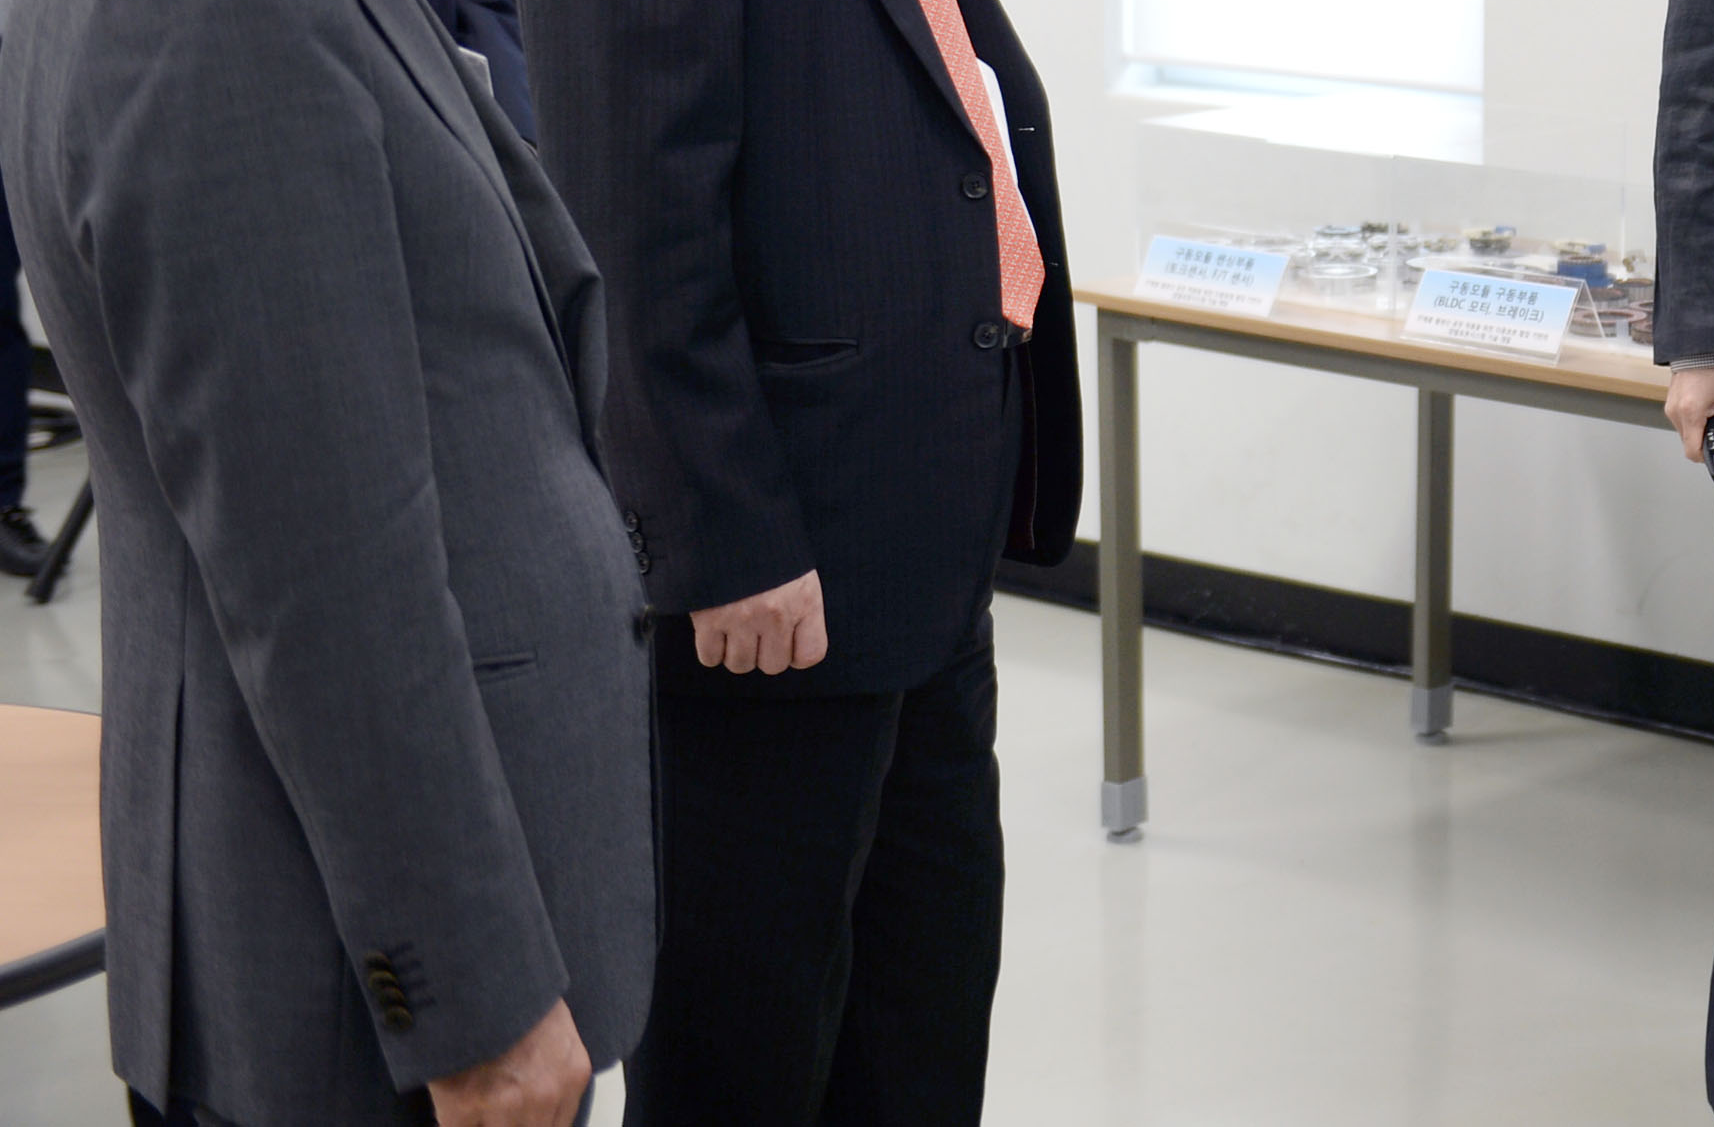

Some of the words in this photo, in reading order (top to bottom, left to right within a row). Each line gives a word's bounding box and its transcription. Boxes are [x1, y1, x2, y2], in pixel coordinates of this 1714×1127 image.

[1449, 279, 1492, 299] 구동모듈
[1495, 286, 1539, 306] 구동부품
[1434, 295, 1466, 310] (BLDC
[1495, 304, 1545, 324] 브레이크)
